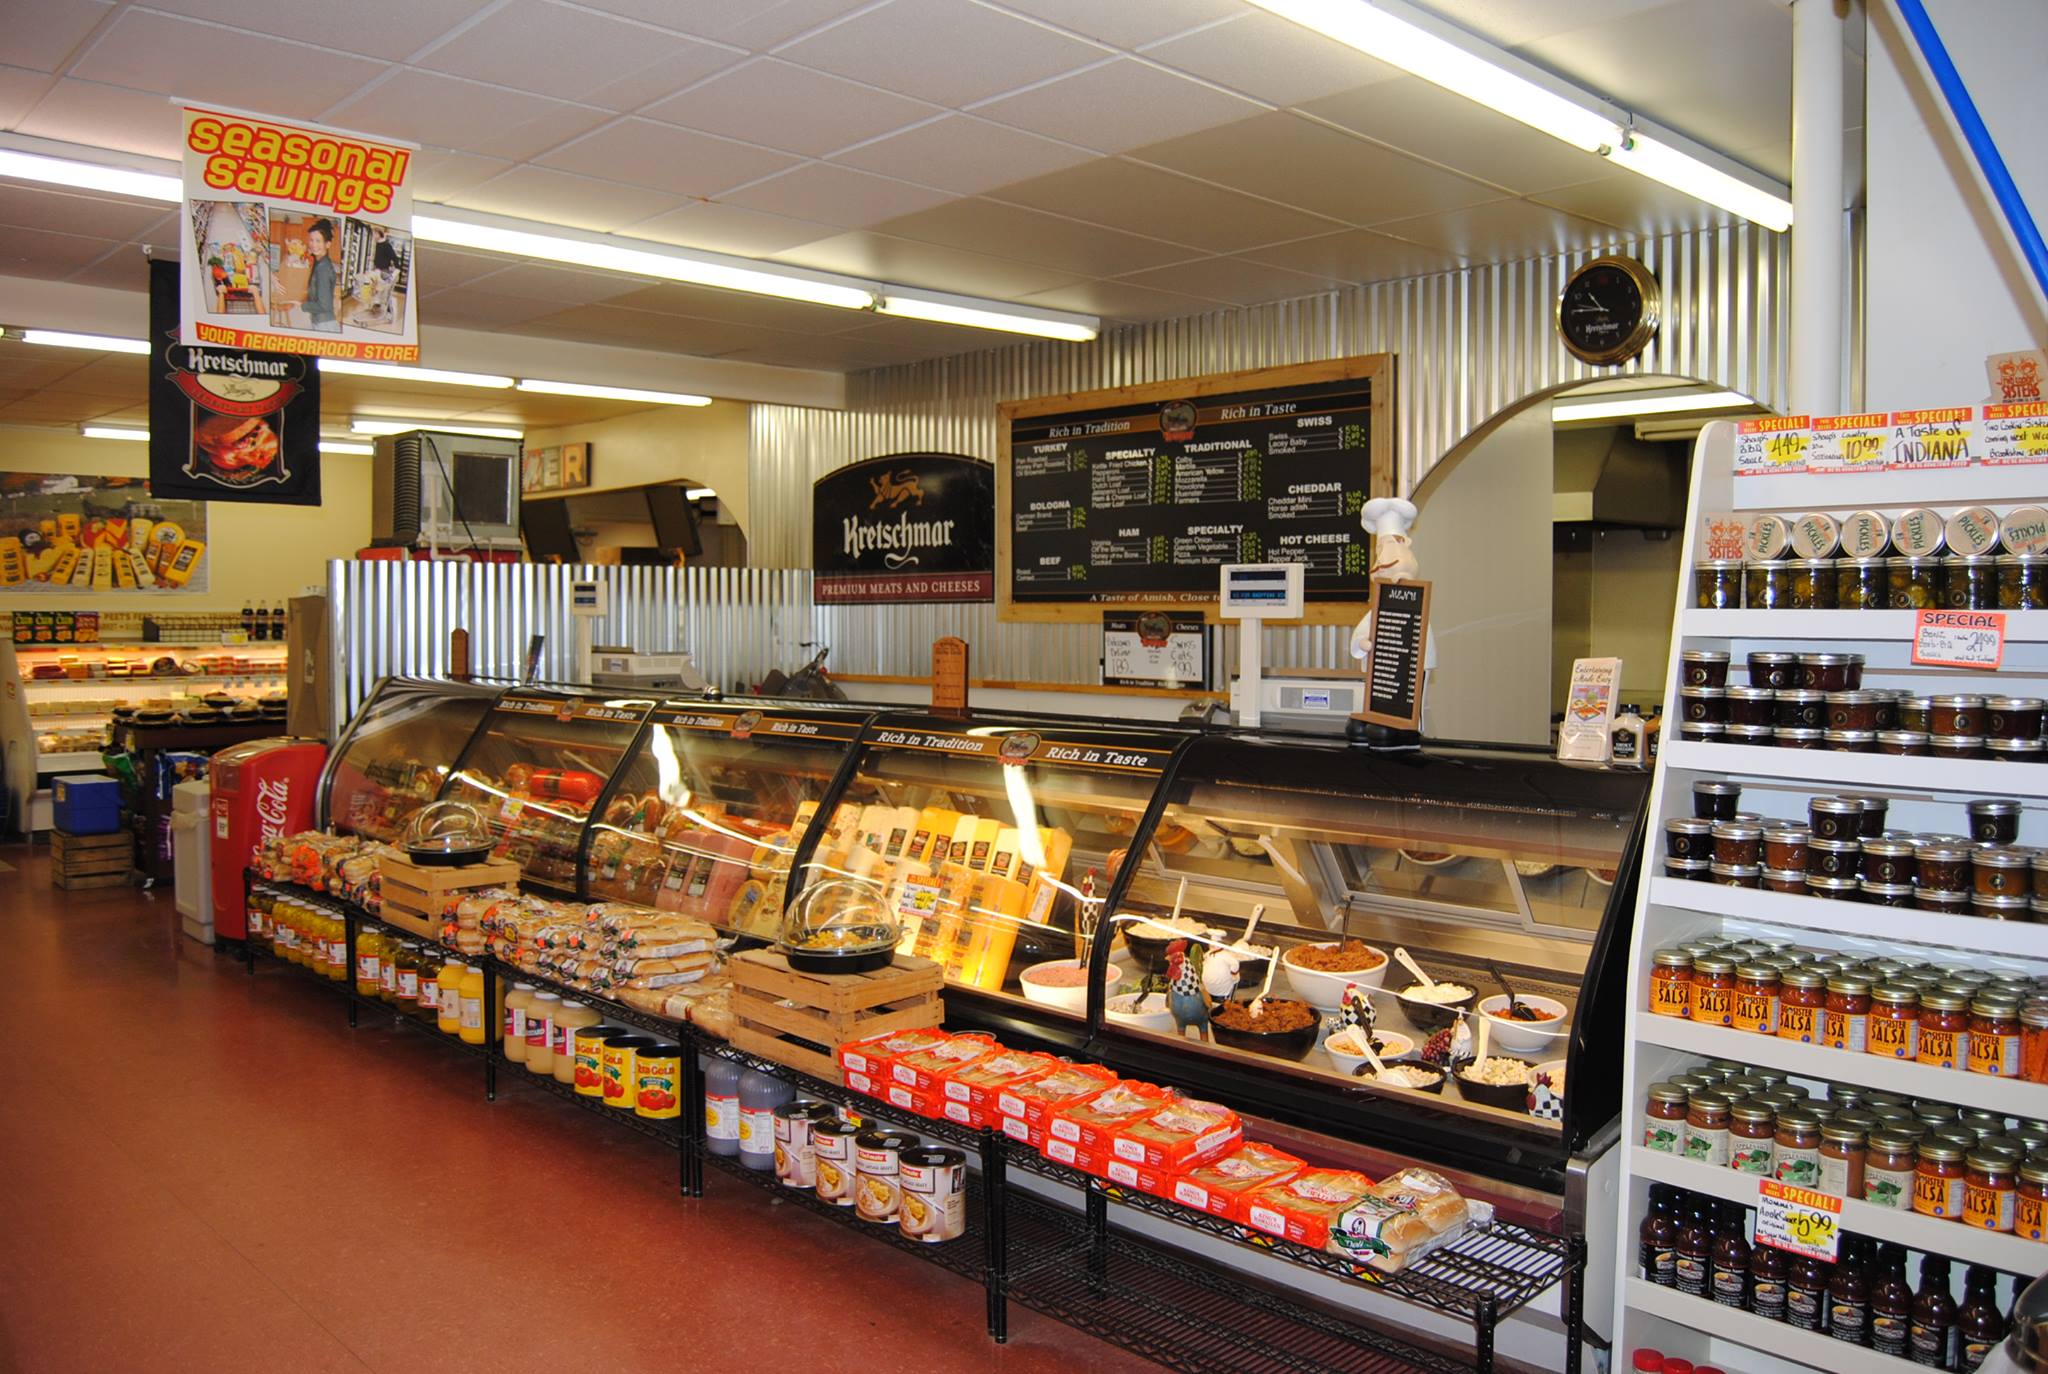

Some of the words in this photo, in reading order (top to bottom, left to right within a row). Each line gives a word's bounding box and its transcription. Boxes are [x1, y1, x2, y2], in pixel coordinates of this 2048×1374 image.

[189, 118, 409, 187] seasonal
[204, 150, 393, 213] savings
[200, 326, 236, 345] YOUR
[243, 332, 358, 359] NEIGHBORHOOD
[364, 345, 418, 362] STORE!
[188, 348, 288, 379] Kretschmar
[1221, 407, 1246, 420] Rich
[1249, 406, 1260, 417] in
[1265, 403, 1297, 416] Taste
[1049, 427, 1070, 438] Rich
[1072, 426, 1082, 435] in
[1085, 420, 1130, 434] Tradition
[1297, 416, 1333, 428] SWISS
[1759, 418, 1805, 431] SPECIAL!
[1834, 415, 1882, 429] SPECIAL!
[1896, 427, 1904, 438] A
[1910, 423, 1940, 437] Taste
[1946, 418, 1962, 436] of
[1033, 443, 1068, 454] TURKEY
[1105, 448, 1156, 460] SPECIALTY
[1184, 440, 1252, 453] TRADITIONAL
[1892, 438, 1970, 464] INDIANA
[1288, 482, 1342, 494] CHEDDAR
[1030, 500, 1071, 512] BOLOGNA
[1118, 528, 1140, 537] HAM
[1187, 525, 1244, 536] SPECIALTY
[1280, 536, 1302, 544] HOT
[1305, 534, 1350, 544] CHEESE
[1758, 522, 1772, 554] PICKLES
[1803, 522, 1826, 550] PICKLES
[1859, 518, 1870, 552] PICKLES
[1909, 516, 1925, 550] PICKLES
[1958, 516, 1987, 546] PICKLES
[843, 511, 954, 569] Kretschmar
[1040, 557, 1062, 566] BEEF
[822, 584, 866, 596] PREMIUM
[870, 582, 903, 594] MEATS
[905, 581, 928, 594] AND
[932, 580, 980, 593] CHEESES
[1100, 594, 1126, 602] Taste
[1180, 594, 1211, 602] Close
[1923, 613, 1997, 628] SPECIAL
[877, 731, 902, 743] Rich
[904, 733, 920, 745] in
[922, 735, 984, 752] Tradition
[1046, 748, 1080, 761] Rich
[1082, 750, 1100, 762] in
[1103, 751, 1149, 767] Taste
[1658, 988, 1690, 1004] SALSA
[1700, 996, 1732, 1012] SALSA
[1736, 1002, 1768, 1020] SALSA
[1780, 1014, 1812, 1032] SALSA
[1871, 1024, 1906, 1044] SALSA
[1784, 1186, 1835, 1210] SPECIAL!
